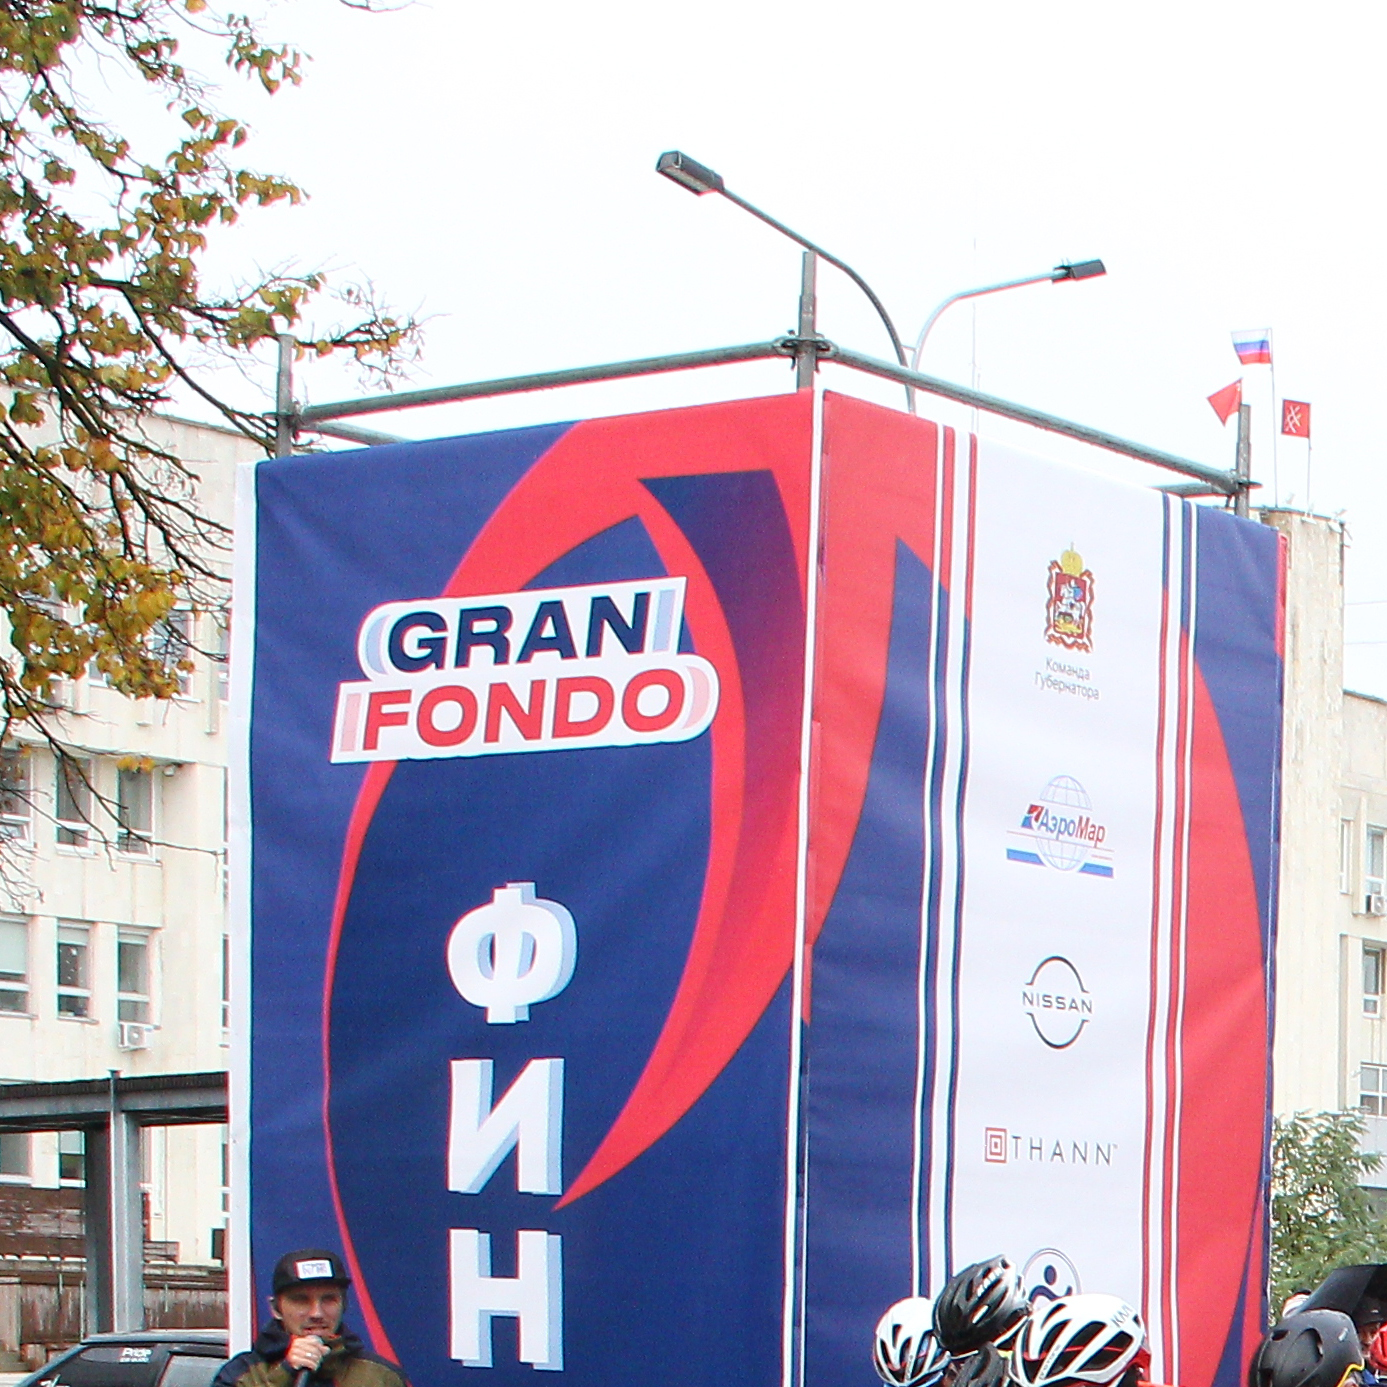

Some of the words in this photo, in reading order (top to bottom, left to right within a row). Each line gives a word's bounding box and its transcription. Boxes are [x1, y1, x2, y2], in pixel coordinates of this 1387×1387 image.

[387, 590, 651, 674] GRAN
[1035, 671, 1100, 700] Губернатора
[1045, 657, 1090, 681] Команда
[361, 668, 686, 752] FONDO
[1039, 808, 1107, 848] АэроМар
[1021, 989, 1094, 1015] NISSAN
[1012, 1134, 1113, 1167] THANN
